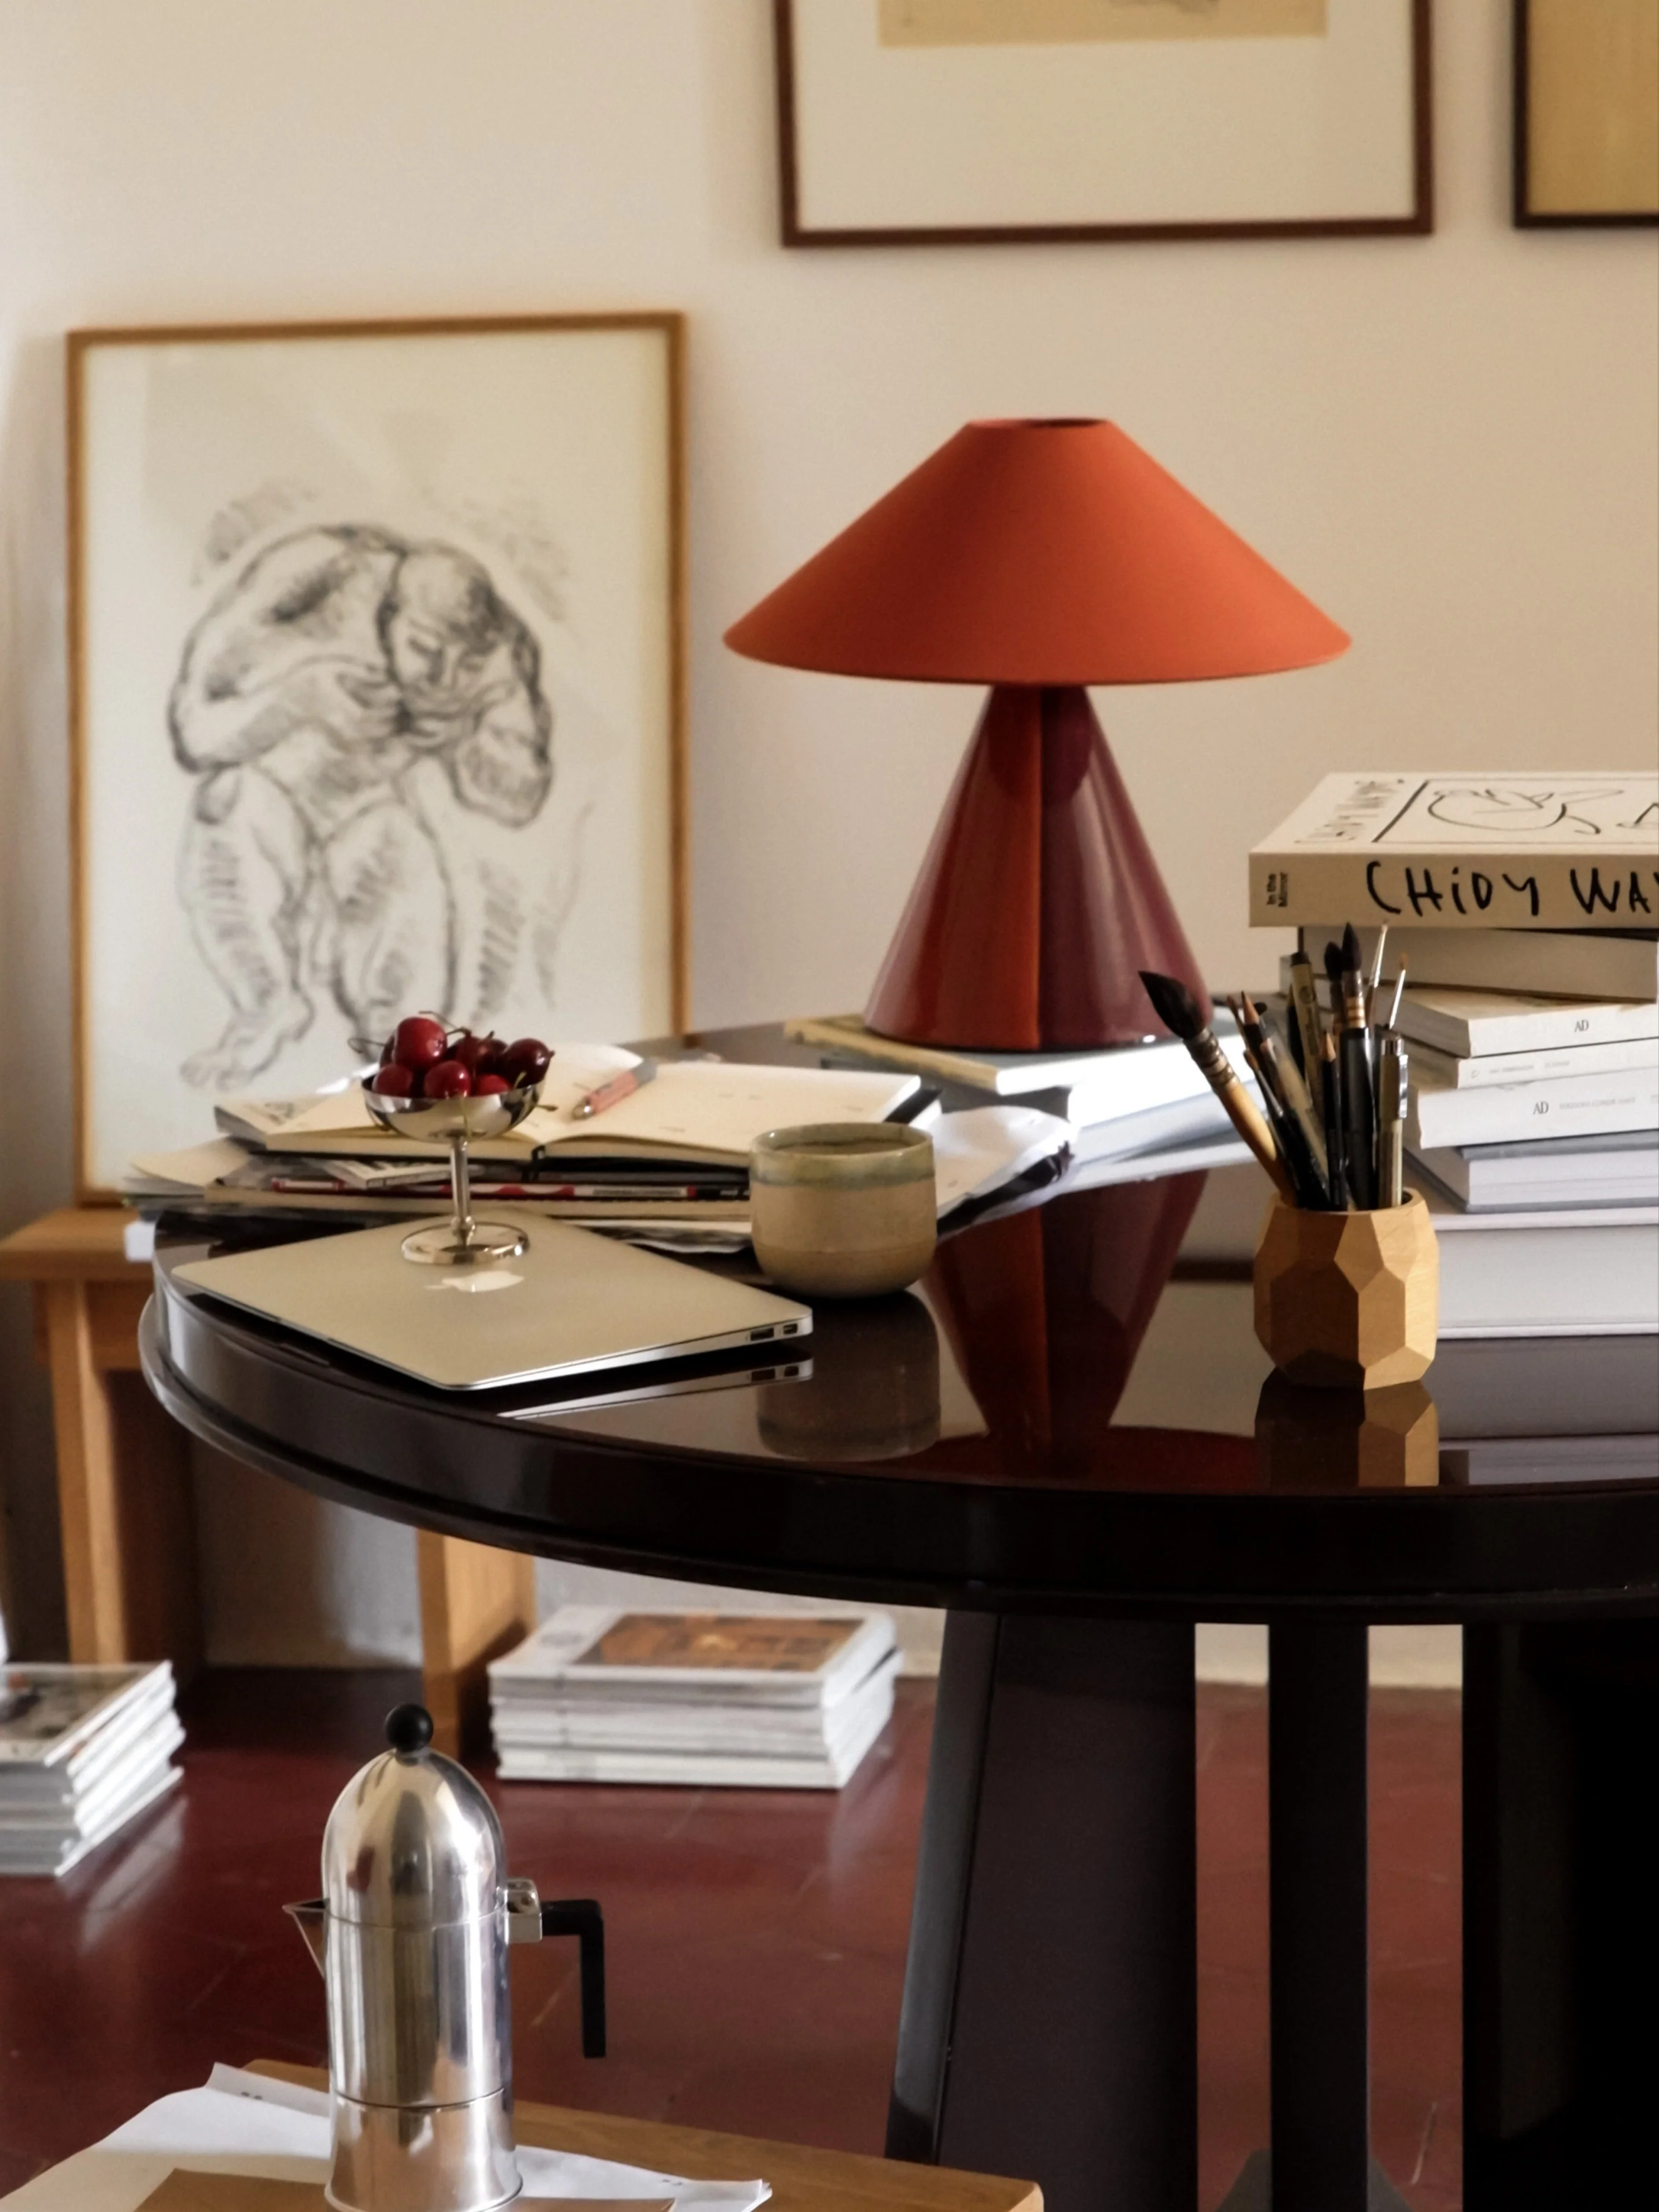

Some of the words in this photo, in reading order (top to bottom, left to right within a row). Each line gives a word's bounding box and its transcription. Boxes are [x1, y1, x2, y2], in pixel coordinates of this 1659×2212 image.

[1570, 867, 1659, 915] WA
[1574, 1019, 1589, 1032] AD
[1533, 1101, 1549, 1114] AD
